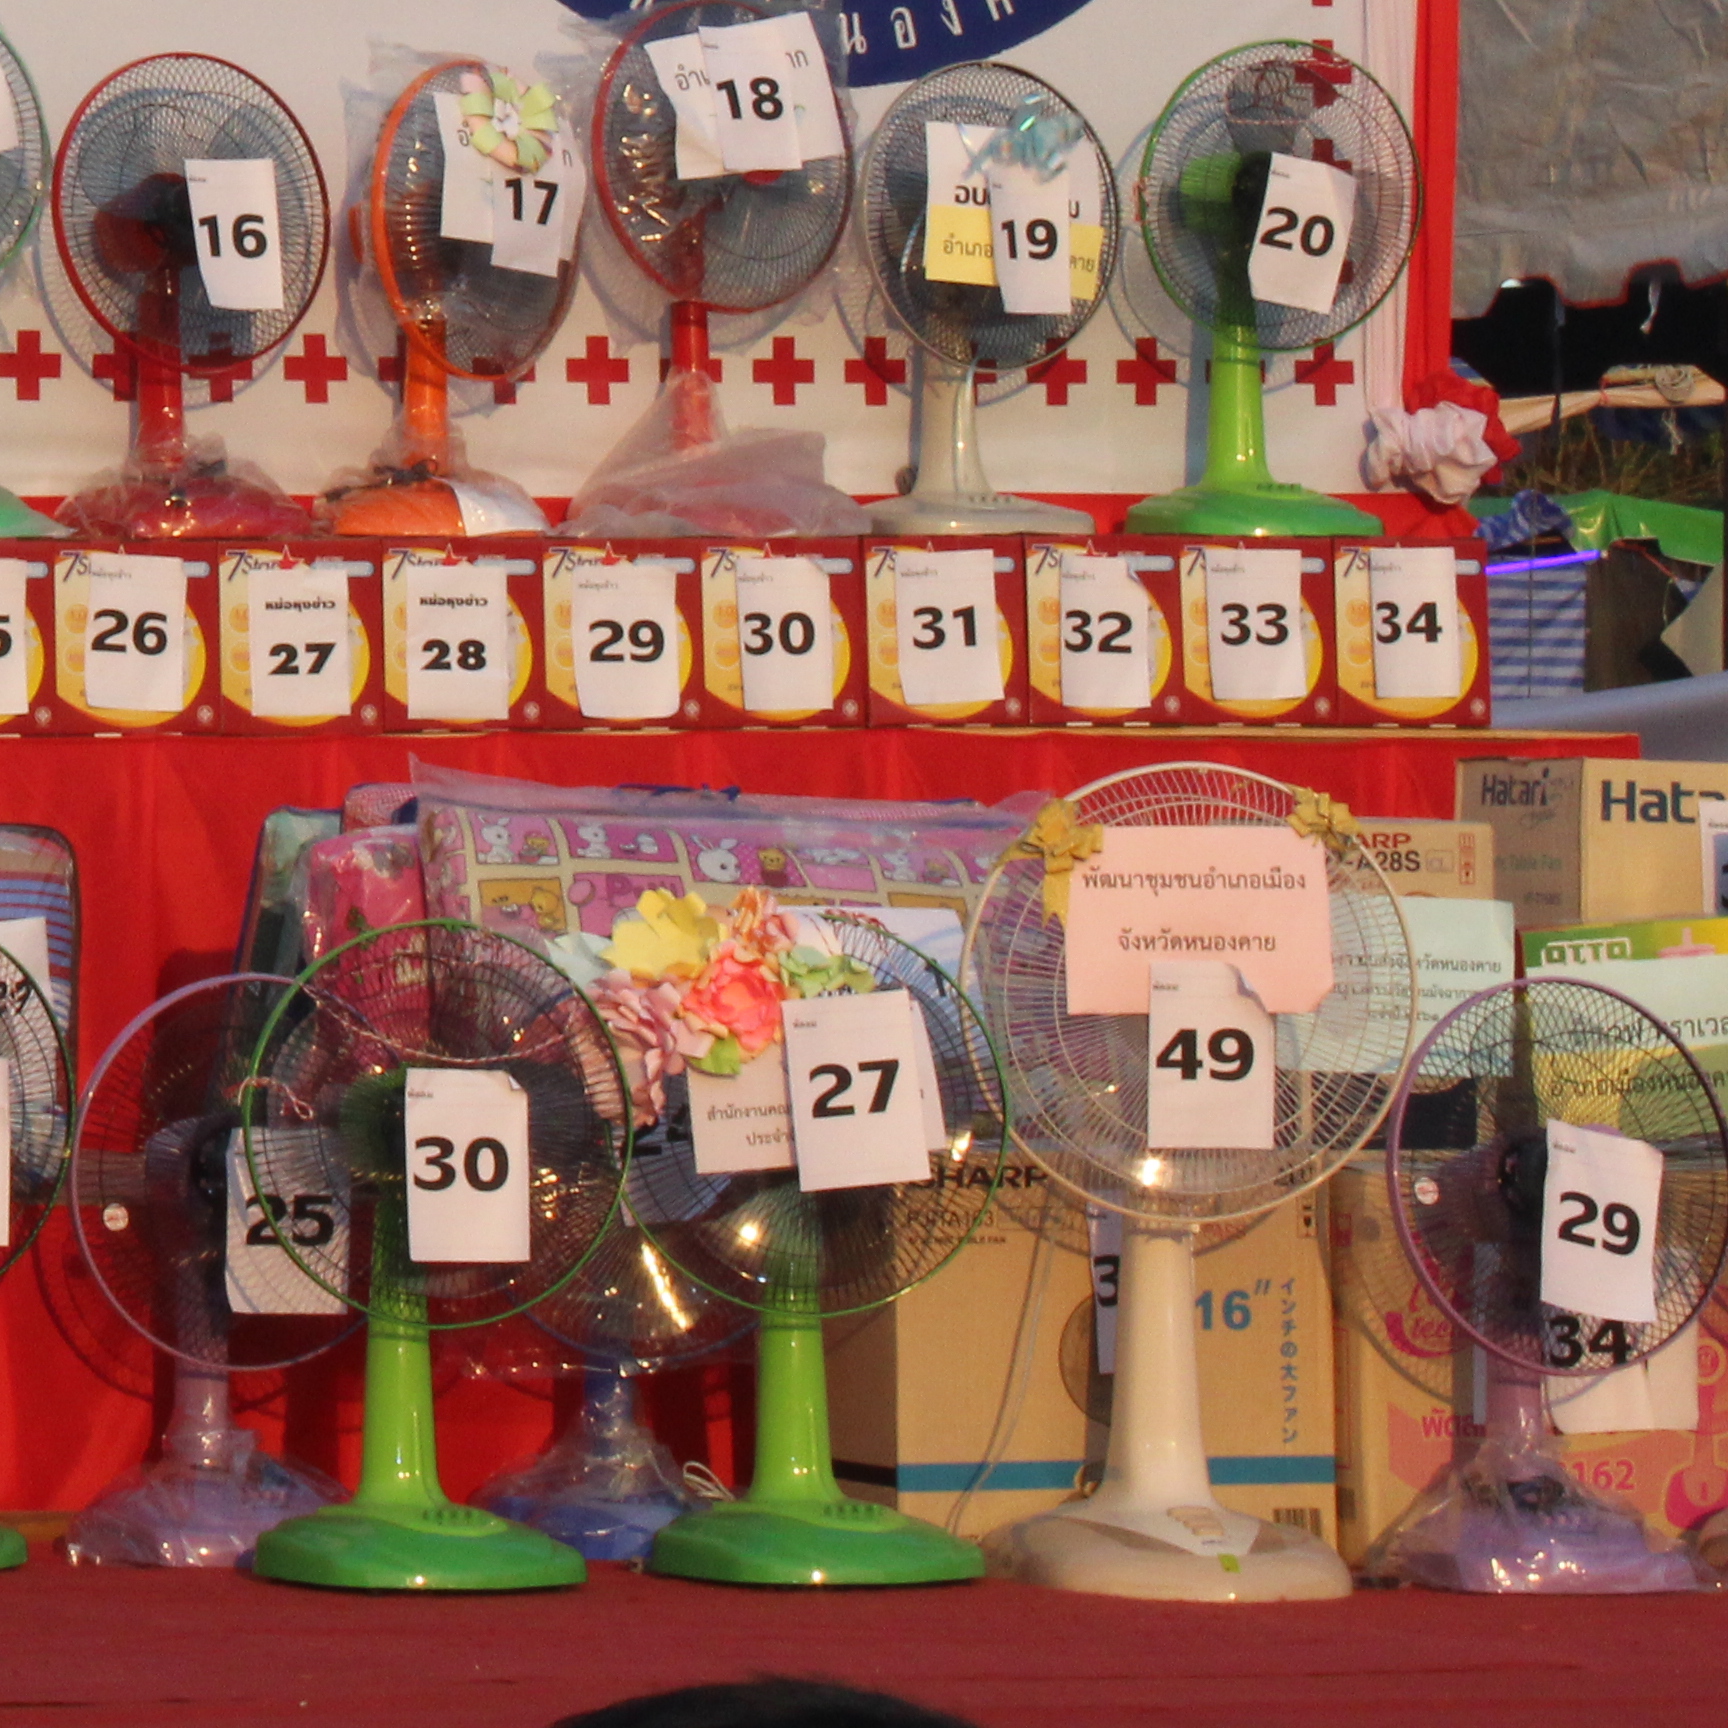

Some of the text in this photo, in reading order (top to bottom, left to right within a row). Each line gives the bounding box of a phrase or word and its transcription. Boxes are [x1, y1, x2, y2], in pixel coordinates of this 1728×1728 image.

[717, 76, 784, 121] 18
[504, 177, 558, 226] 17
[199, 214, 269, 259] 16
[1001, 218, 1058, 261] 19
[1260, 206, 1335, 258] 20
[90, 609, 168, 656] 26
[588, 619, 666, 664] 29
[744, 611, 816, 656] 30
[912, 605, 977, 650] 31
[1063, 609, 1134, 655] 32
[1220, 602, 1290, 647] 33
[1375, 600, 1443, 645] 34
[268, 642, 337, 675] 27
[421, 639, 487, 671] 28
[1481, 767, 1550, 807] Hatari
[1356, 832, 1414, 849] ARP
[1117, 929, 1277, 954] จังหวัดหนองคาย
[1155, 1028, 1255, 1084] 49
[809, 1059, 900, 1119] 27
[412, 1136, 511, 1192] 30
[245, 1194, 337, 1248] 25
[1559, 1191, 1640, 1256] 29
[1549, 1315, 1631, 1368] 34
